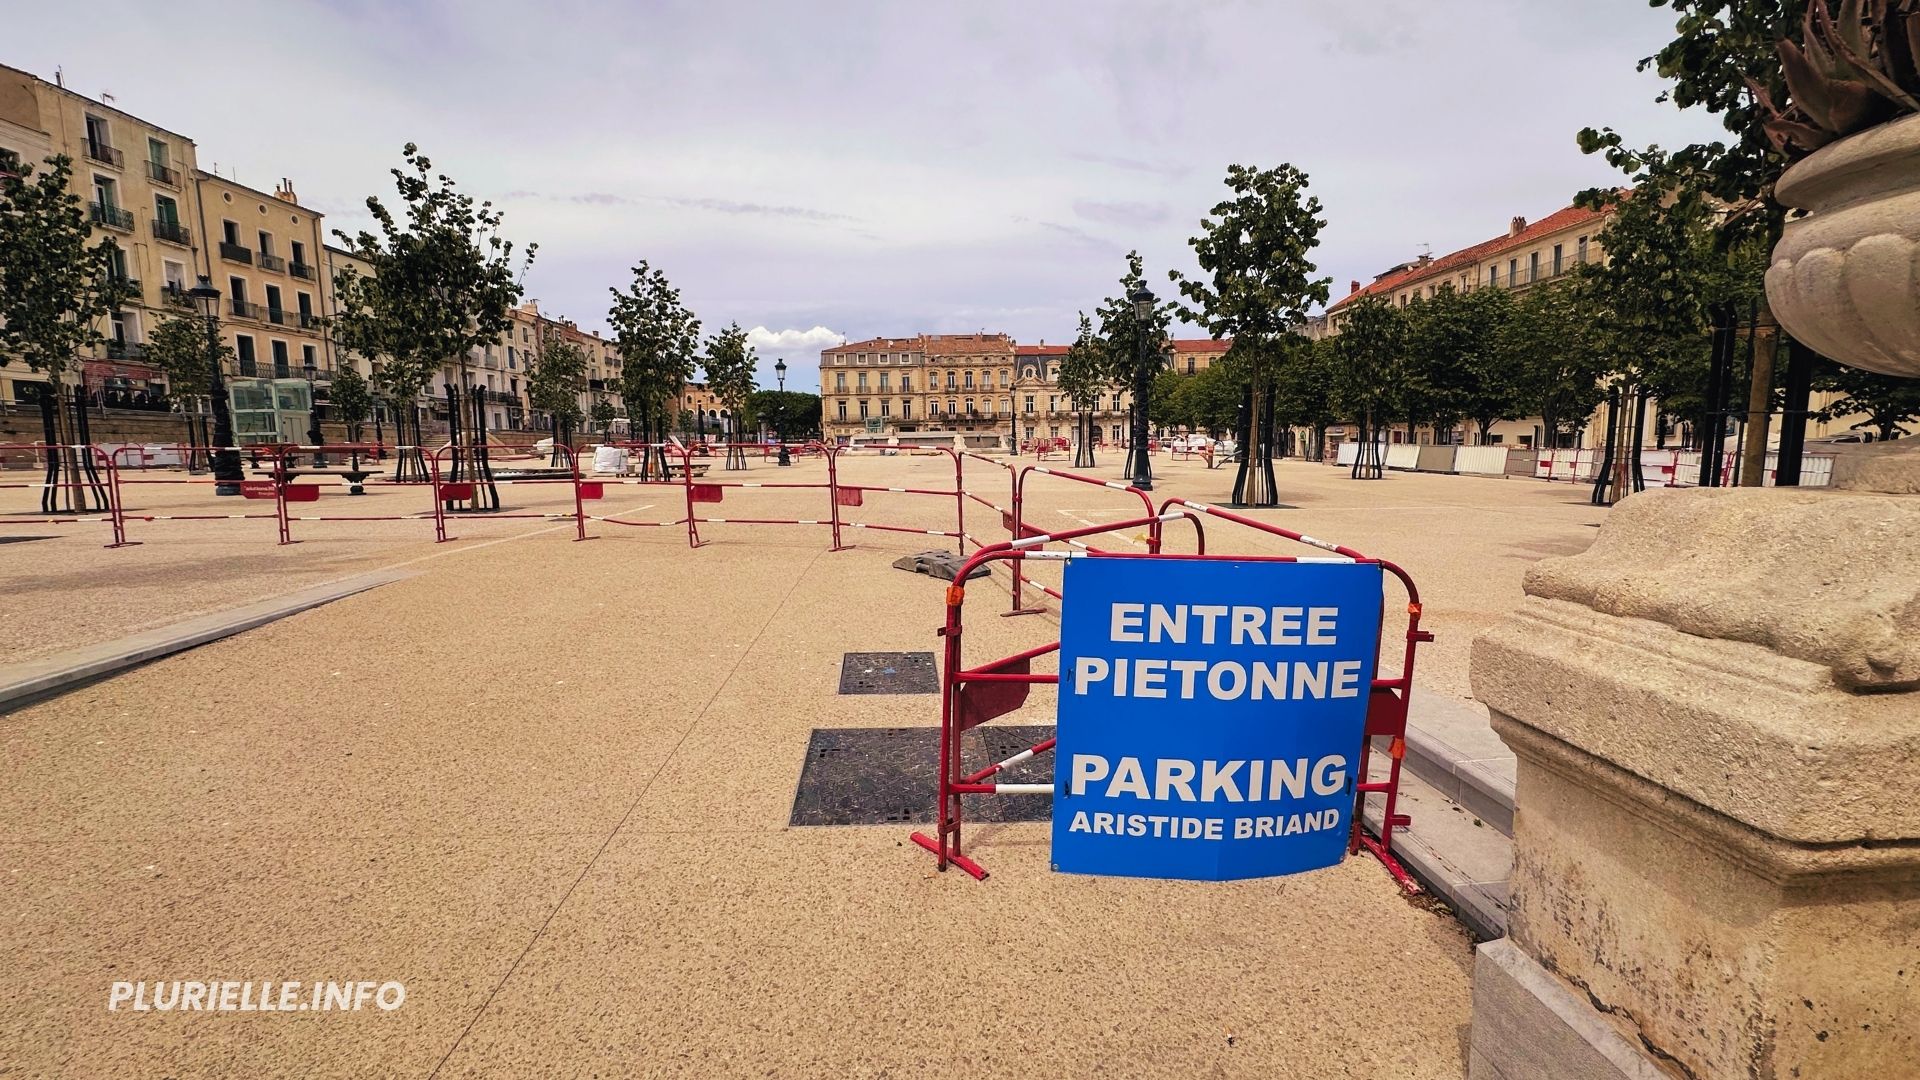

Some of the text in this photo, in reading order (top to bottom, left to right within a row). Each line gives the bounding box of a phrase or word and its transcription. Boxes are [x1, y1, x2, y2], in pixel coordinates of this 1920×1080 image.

[1111, 603, 1339, 646] ENTREE
[1074, 656, 1362, 701] PIETONNE
[1071, 753, 1347, 803] PARKING
[1069, 808, 1340, 840] ARISTIDE BRIAND
